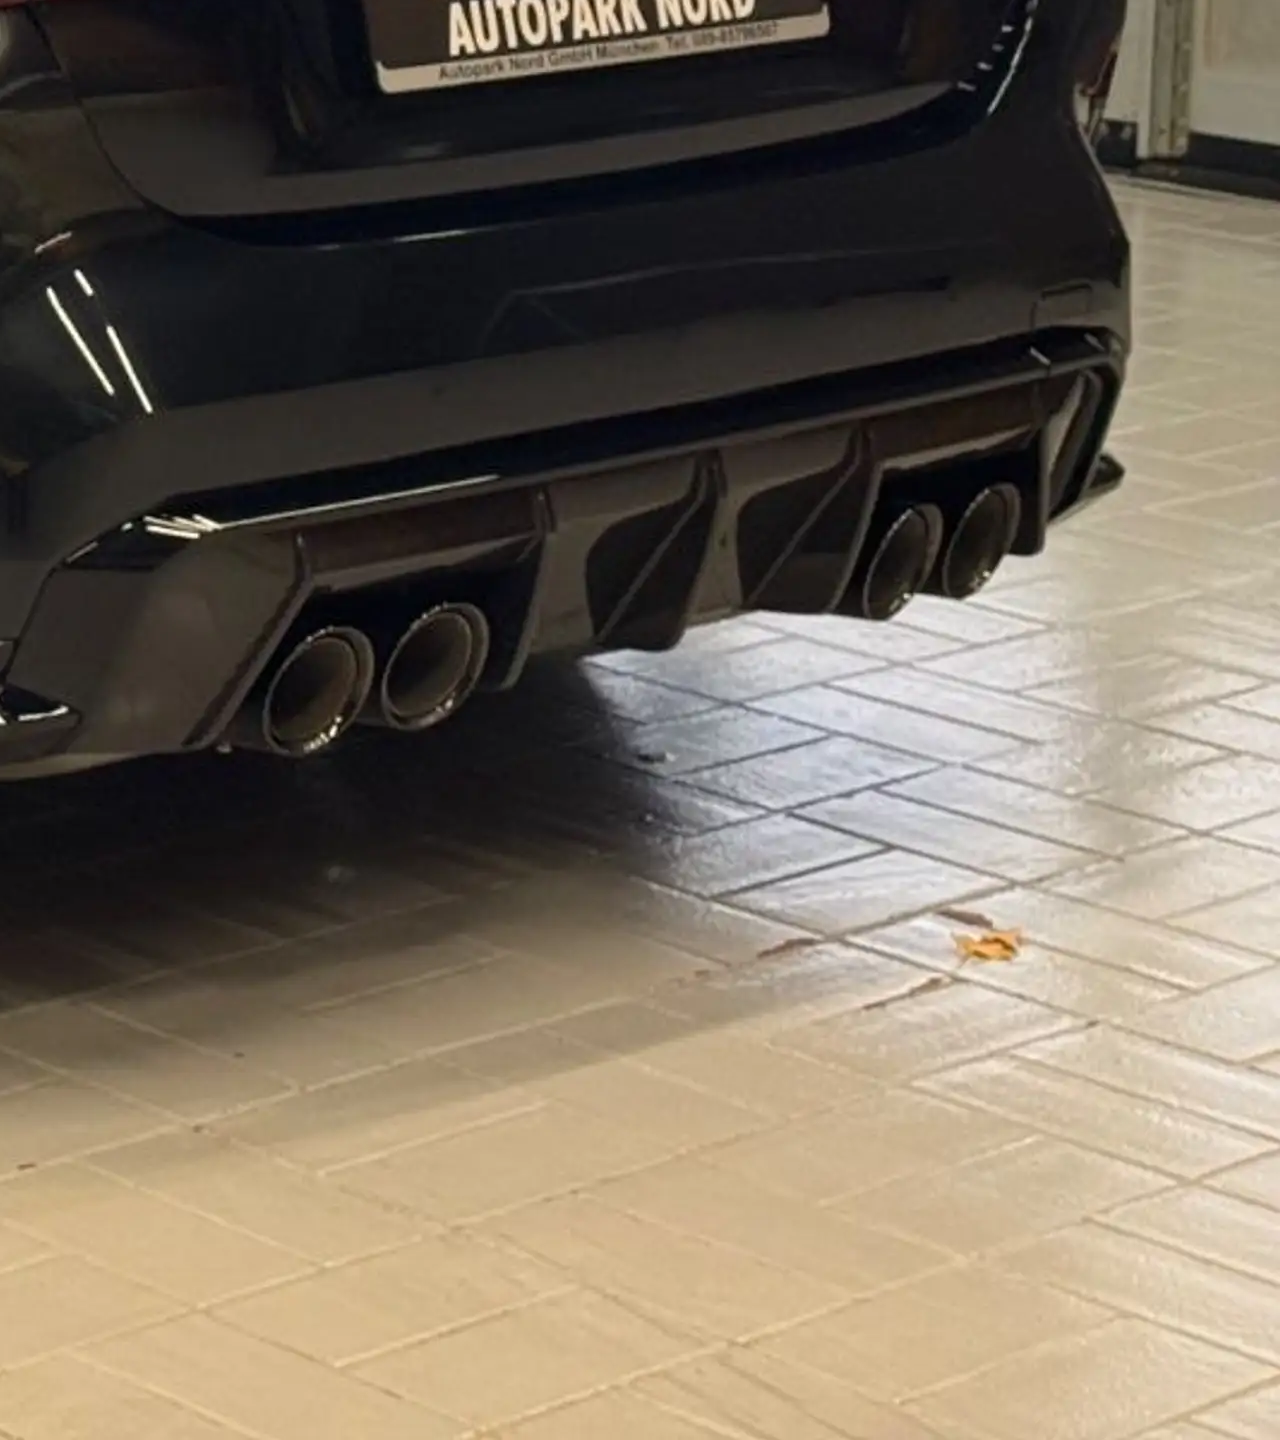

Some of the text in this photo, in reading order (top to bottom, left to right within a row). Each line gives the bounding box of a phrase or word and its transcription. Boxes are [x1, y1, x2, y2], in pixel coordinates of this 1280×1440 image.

[438, 59, 504, 81] Autopark
[509, 54, 544, 72] Nord
[548, 43, 594, 66] GmbH
